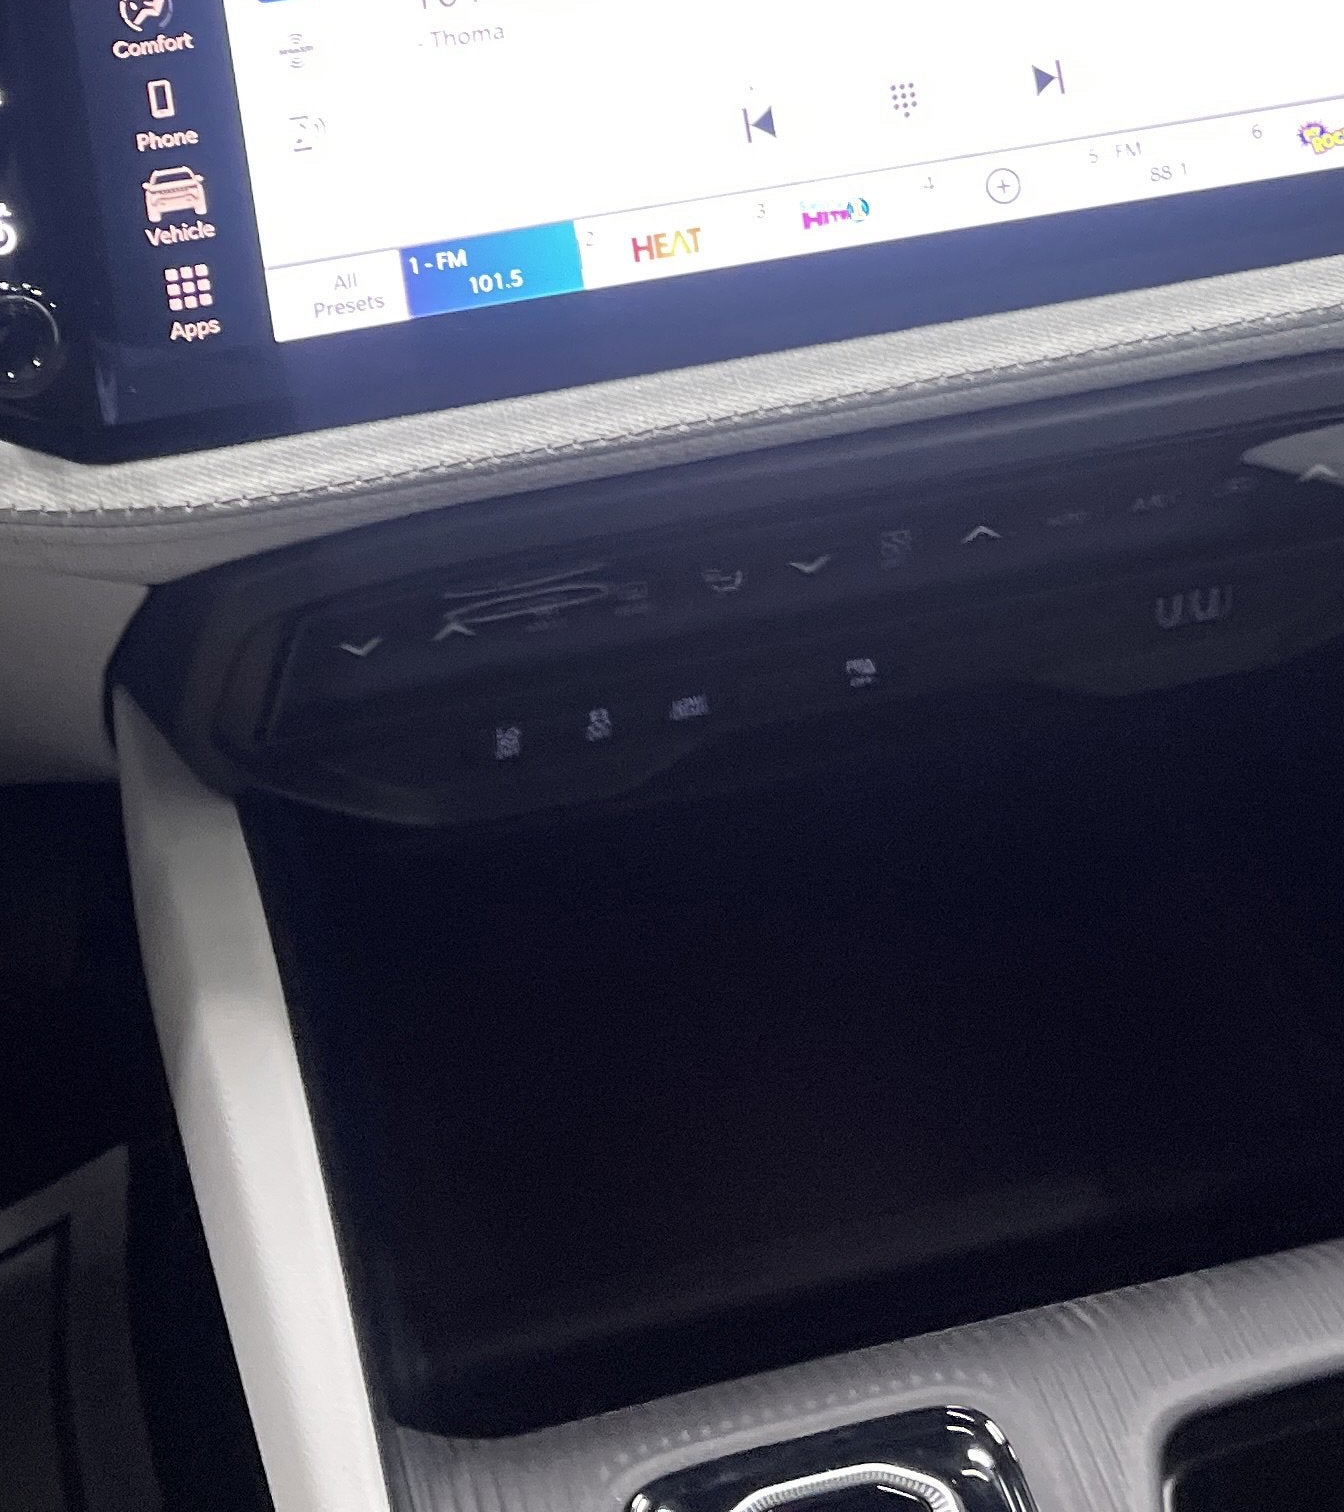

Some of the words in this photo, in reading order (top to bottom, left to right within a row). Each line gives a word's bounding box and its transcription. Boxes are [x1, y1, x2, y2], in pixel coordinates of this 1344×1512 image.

[112, 32, 194, 60] Comfort
[429, 26, 506, 50] Thoma
[136, 127, 199, 152] Phone
[145, 221, 216, 246] Vehicle
[631, 227, 701, 263] HEAT
[437, 250, 468, 270] FM
[334, 273, 357, 291] All
[468, 268, 524, 295] 101.5
[313, 293, 385, 318] Presets
[170, 316, 221, 342] Apps
